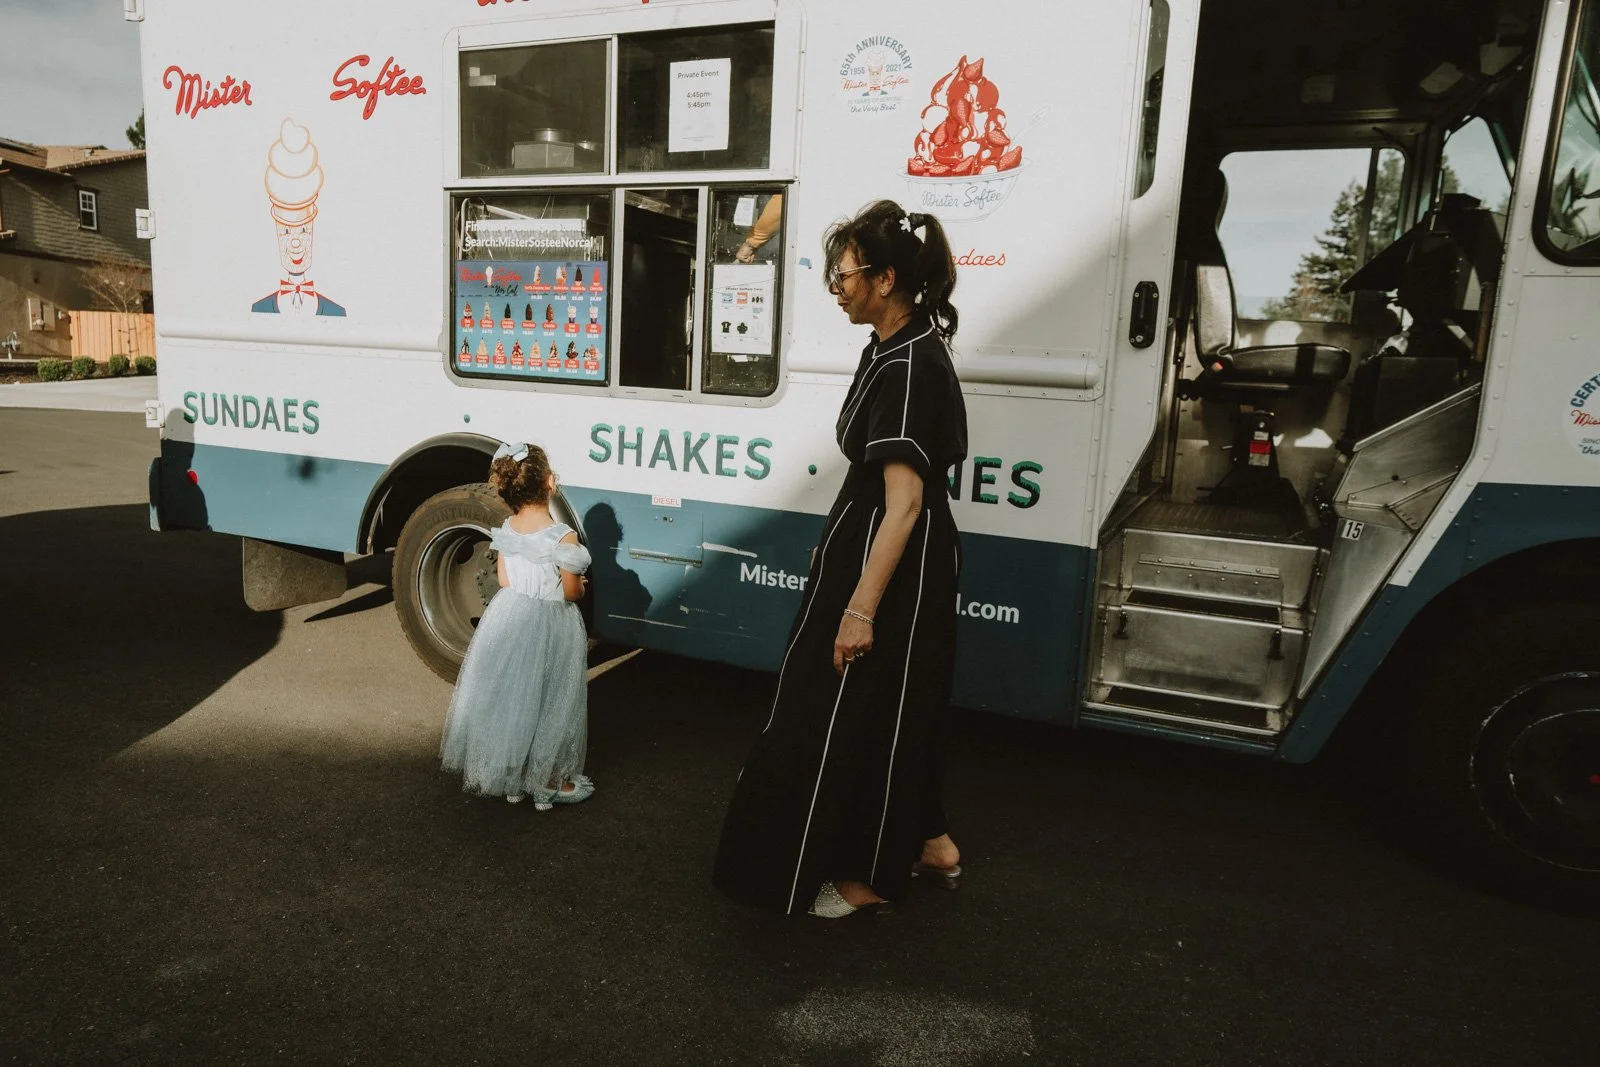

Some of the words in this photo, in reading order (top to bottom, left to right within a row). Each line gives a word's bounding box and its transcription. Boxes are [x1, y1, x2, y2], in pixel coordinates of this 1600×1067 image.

[840, 53, 856, 76] 65th
[856, 36, 913, 70] ANNIVERSARY
[885, 64, 902, 72] 2021
[162, 65, 252, 119] Mister
[329, 54, 426, 120] Softee
[700, 70, 719, 78] Event
[922, 190, 960, 207] Mister
[964, 186, 1004, 209] Softee
[1570, 373, 1600, 408] CERT
[183, 391, 320, 435] SUNDAES
[1570, 409, 1600, 426] Mis
[588, 422, 773, 481] SHAKES
[653, 496, 680, 506] DIESEL
[1346, 521, 1363, 539] 15
[740, 562, 809, 591] Mister
[955, 592, 1020, 624] l.com
